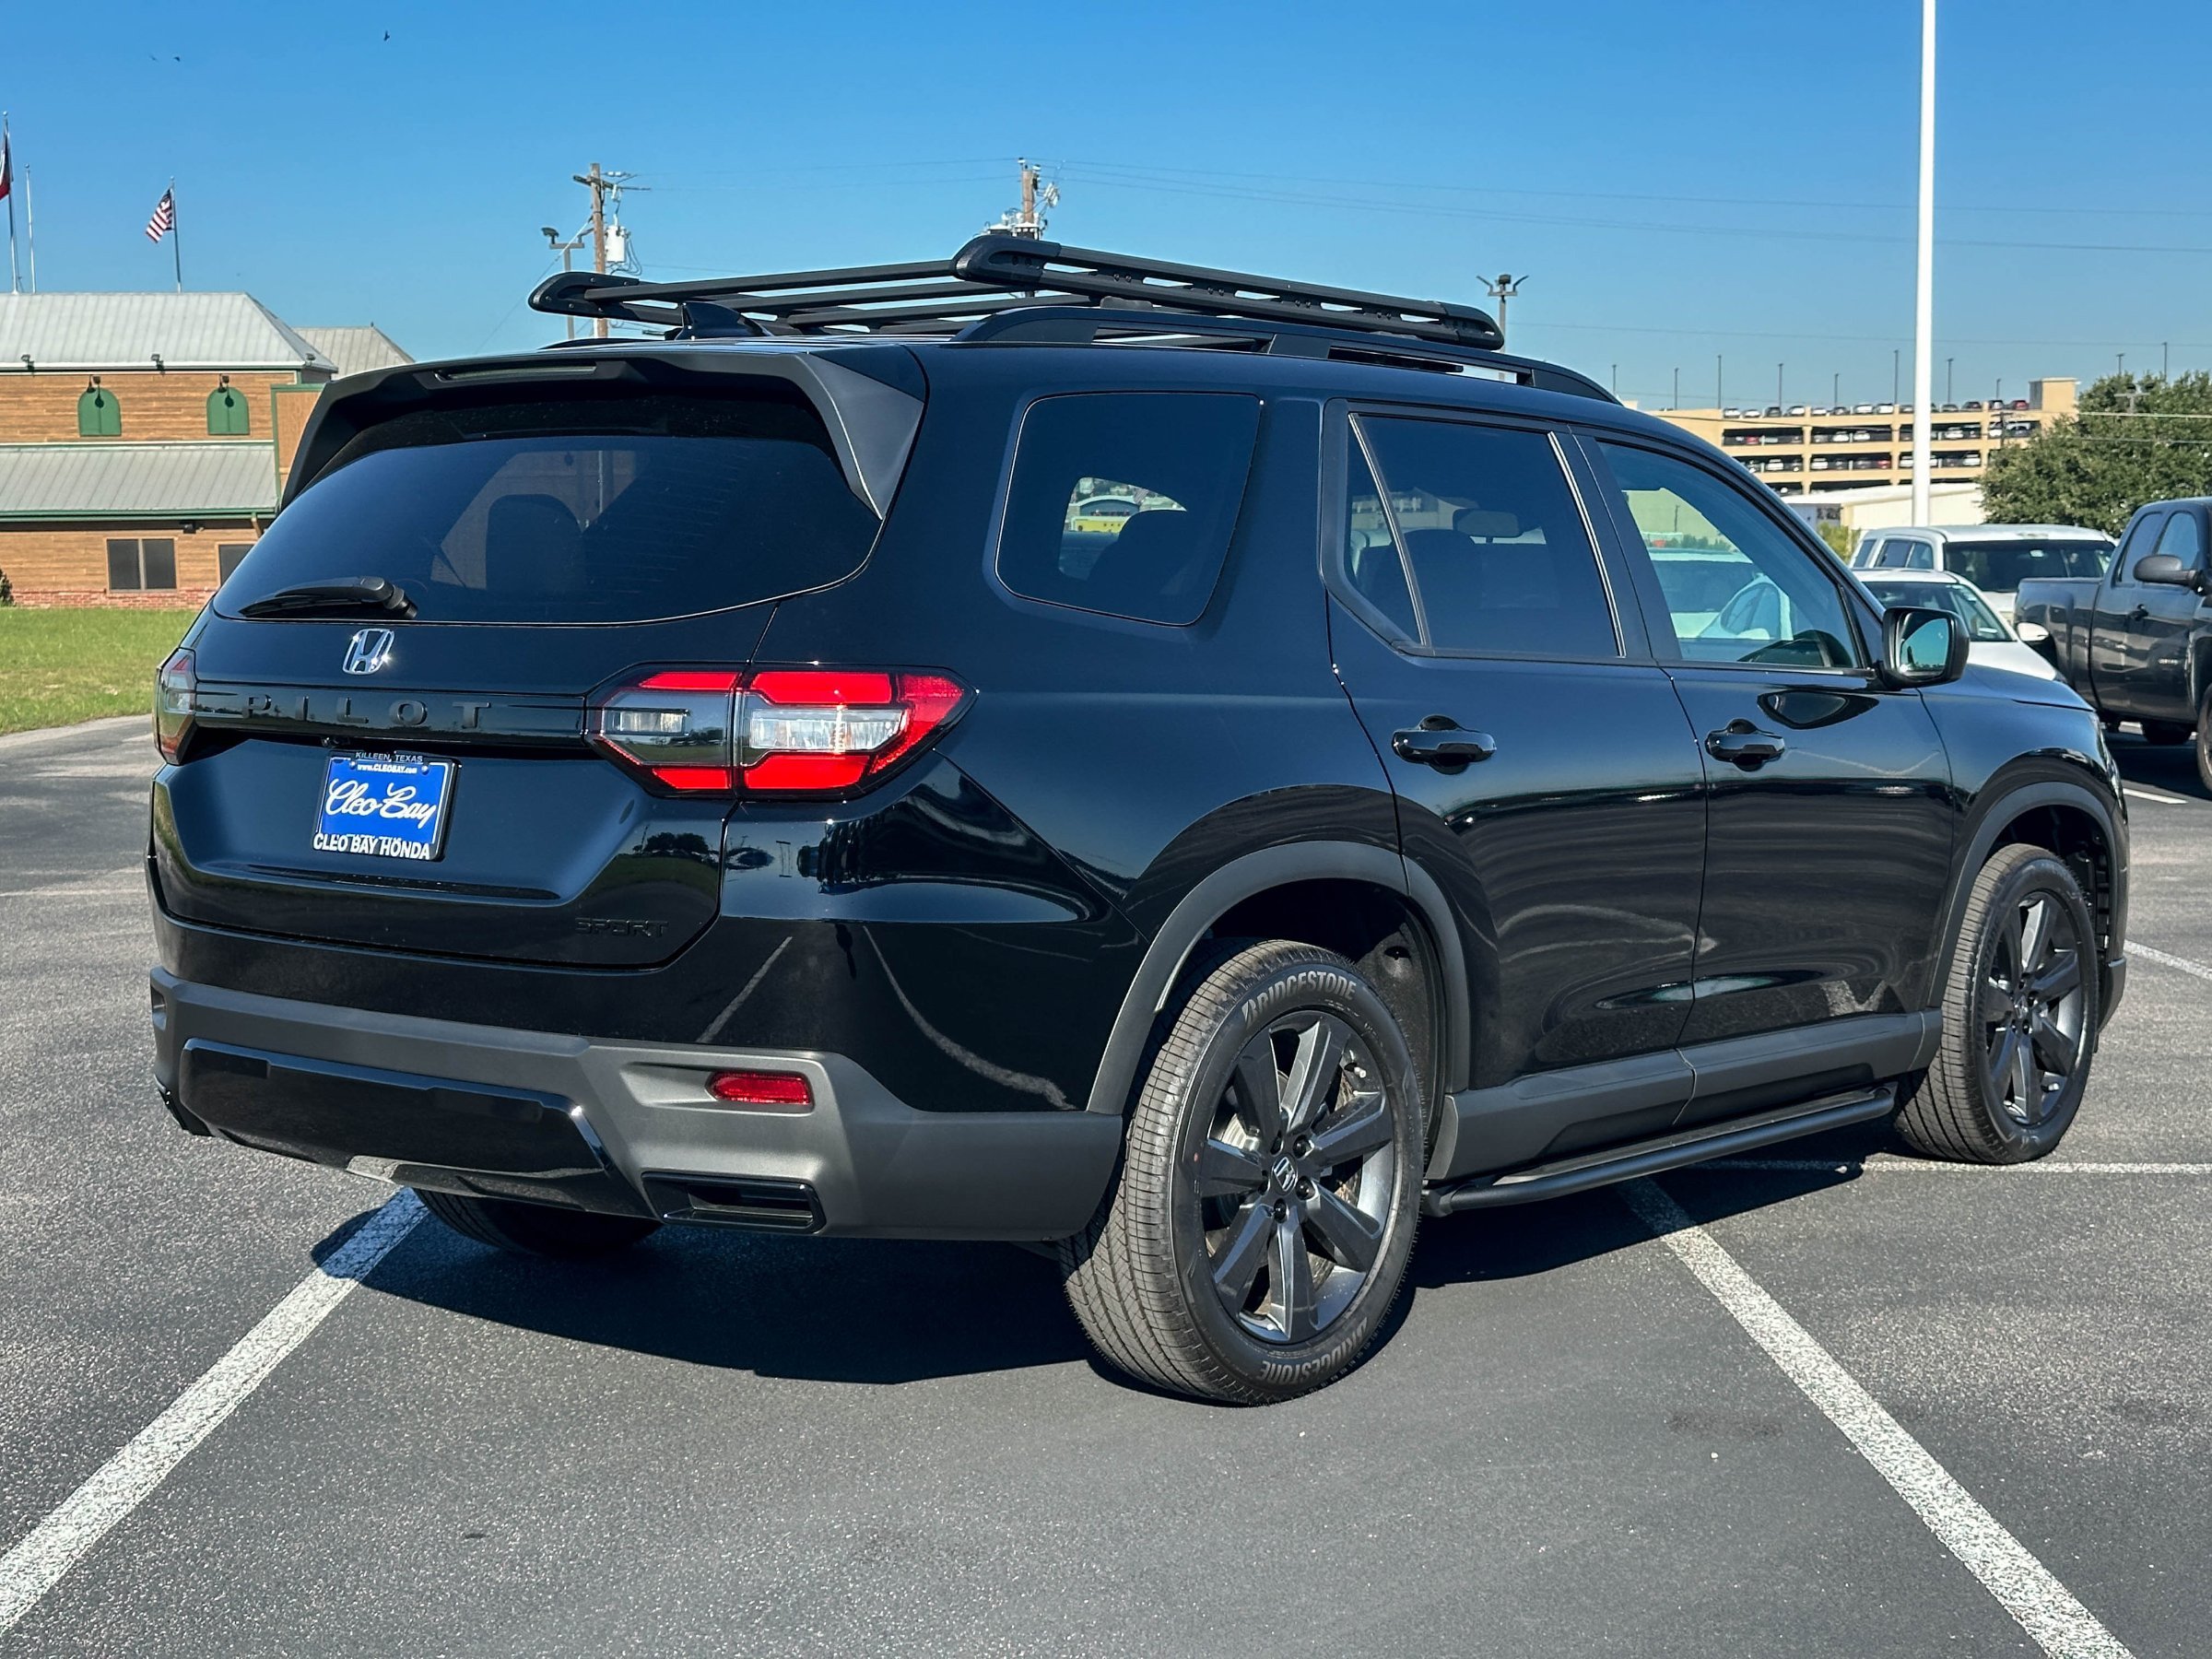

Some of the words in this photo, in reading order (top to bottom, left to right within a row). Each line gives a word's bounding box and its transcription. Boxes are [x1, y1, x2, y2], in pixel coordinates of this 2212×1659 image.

[241, 694, 492, 729] PILOT
[356, 752, 392, 762] KILLEEN,
[394, 754, 423, 762] TEXAS
[358, 764, 417, 774] www.CLEOBAY.com
[325, 779, 382, 816] Cleo
[379, 782, 436, 830] Bay
[313, 833, 348, 852] CLEO
[350, 836, 379, 854] BAY
[379, 838, 430, 860] HONDA
[575, 918, 668, 936] SPORT
[1241, 971, 1357, 1024] BRIDGESTONE
